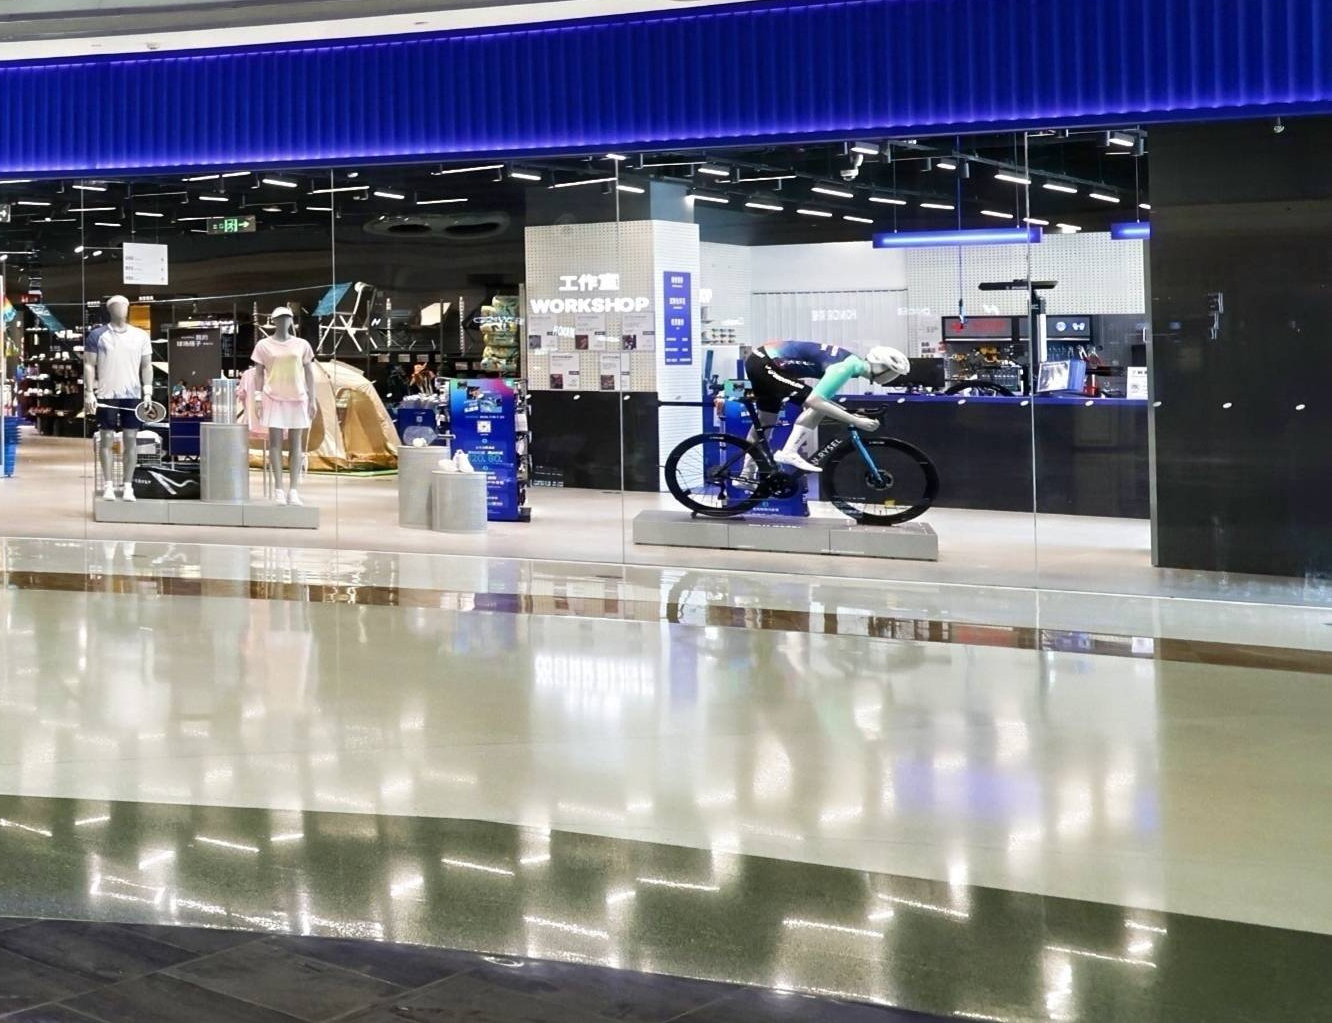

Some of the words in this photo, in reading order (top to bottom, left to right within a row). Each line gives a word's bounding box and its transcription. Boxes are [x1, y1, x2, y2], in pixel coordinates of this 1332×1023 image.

[559, 273, 620, 292] 工作室
[530, 297, 650, 314] WORKSHOP
[818, 438, 843, 458] RYSEL
